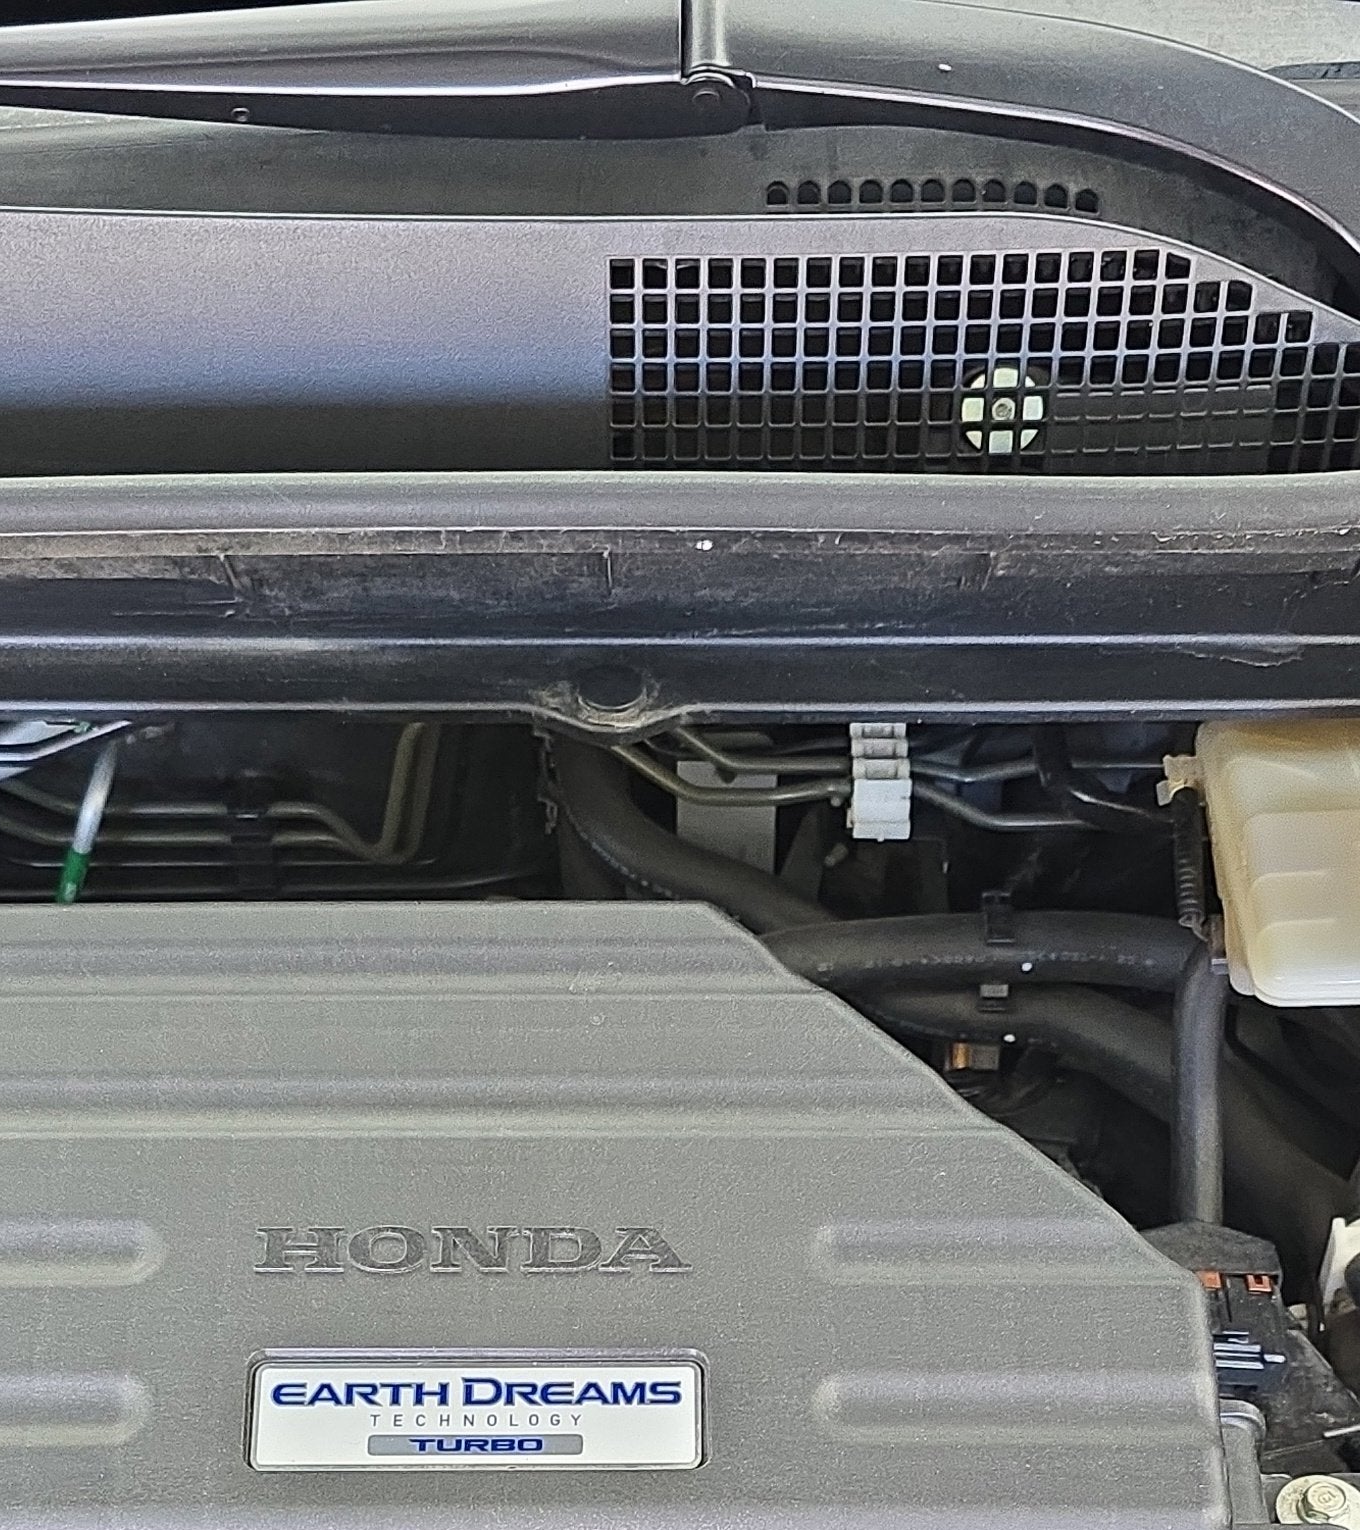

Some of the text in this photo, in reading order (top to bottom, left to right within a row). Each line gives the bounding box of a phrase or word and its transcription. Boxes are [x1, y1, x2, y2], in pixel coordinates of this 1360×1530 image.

[253, 1225, 693, 1274] HONDA
[271, 1377, 683, 1406] EARTH DREAMS
[369, 1413, 583, 1427] TECHNOLOGY
[408, 1436, 544, 1453] TURBO
